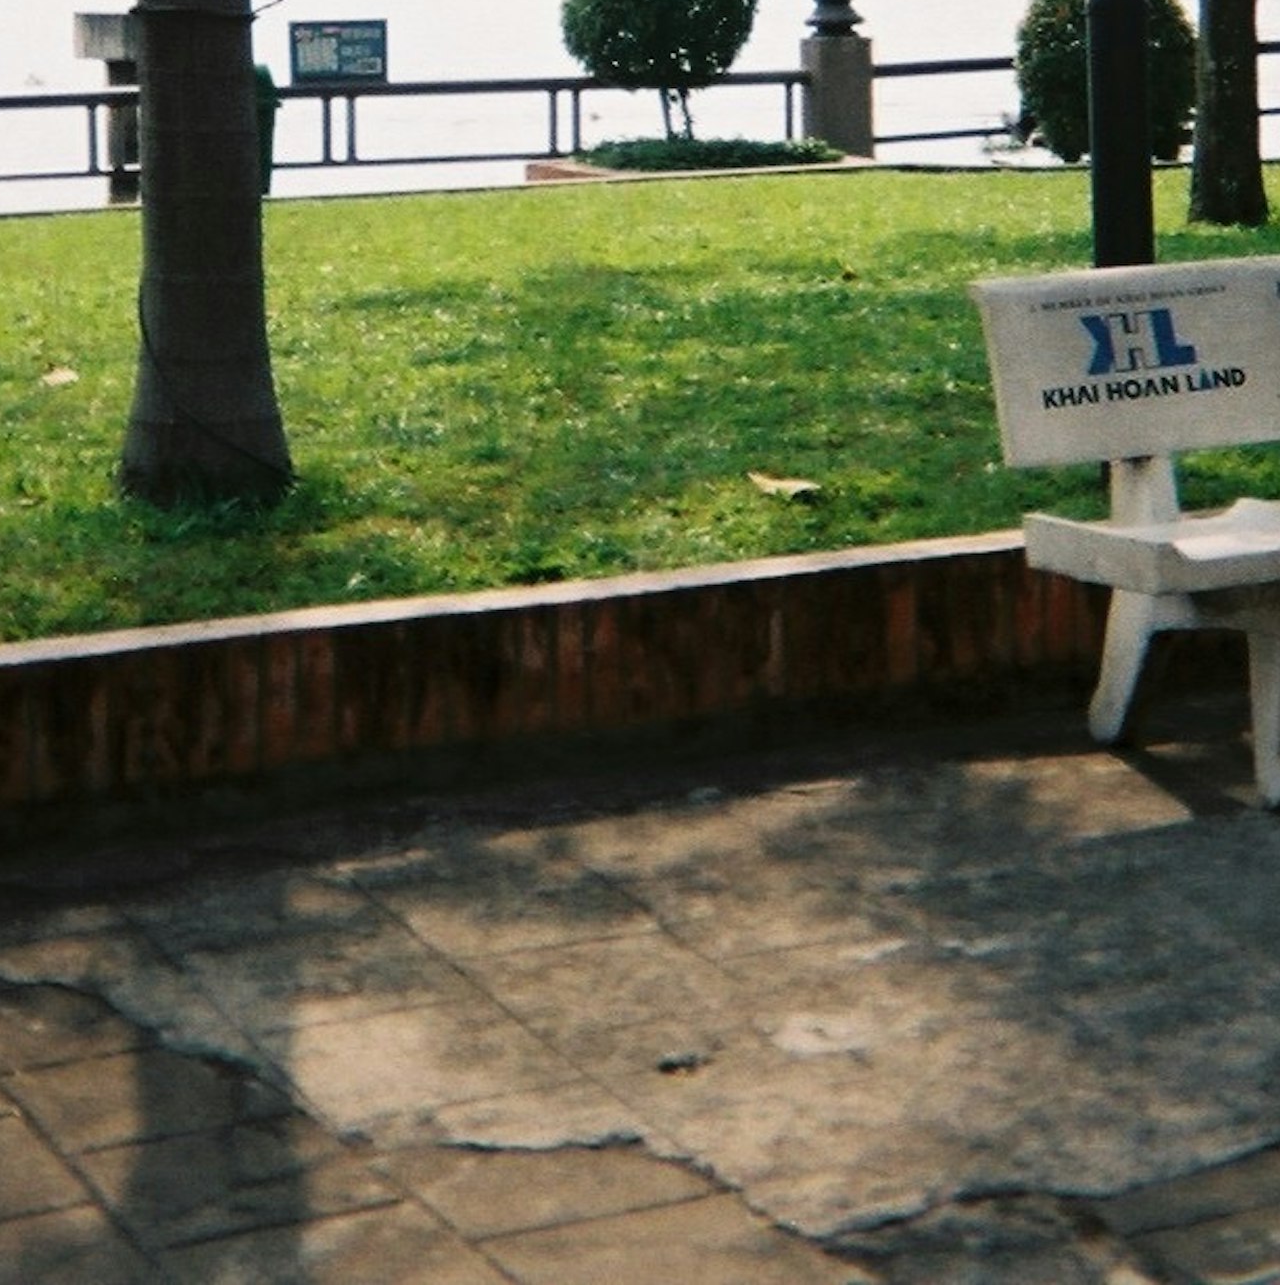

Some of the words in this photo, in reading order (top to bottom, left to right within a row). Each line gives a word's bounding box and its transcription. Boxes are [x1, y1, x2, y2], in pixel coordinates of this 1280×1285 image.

[1042, 383, 1100, 409] KHAI
[1106, 376, 1180, 402] HOAN
[1186, 367, 1246, 391] LAND
